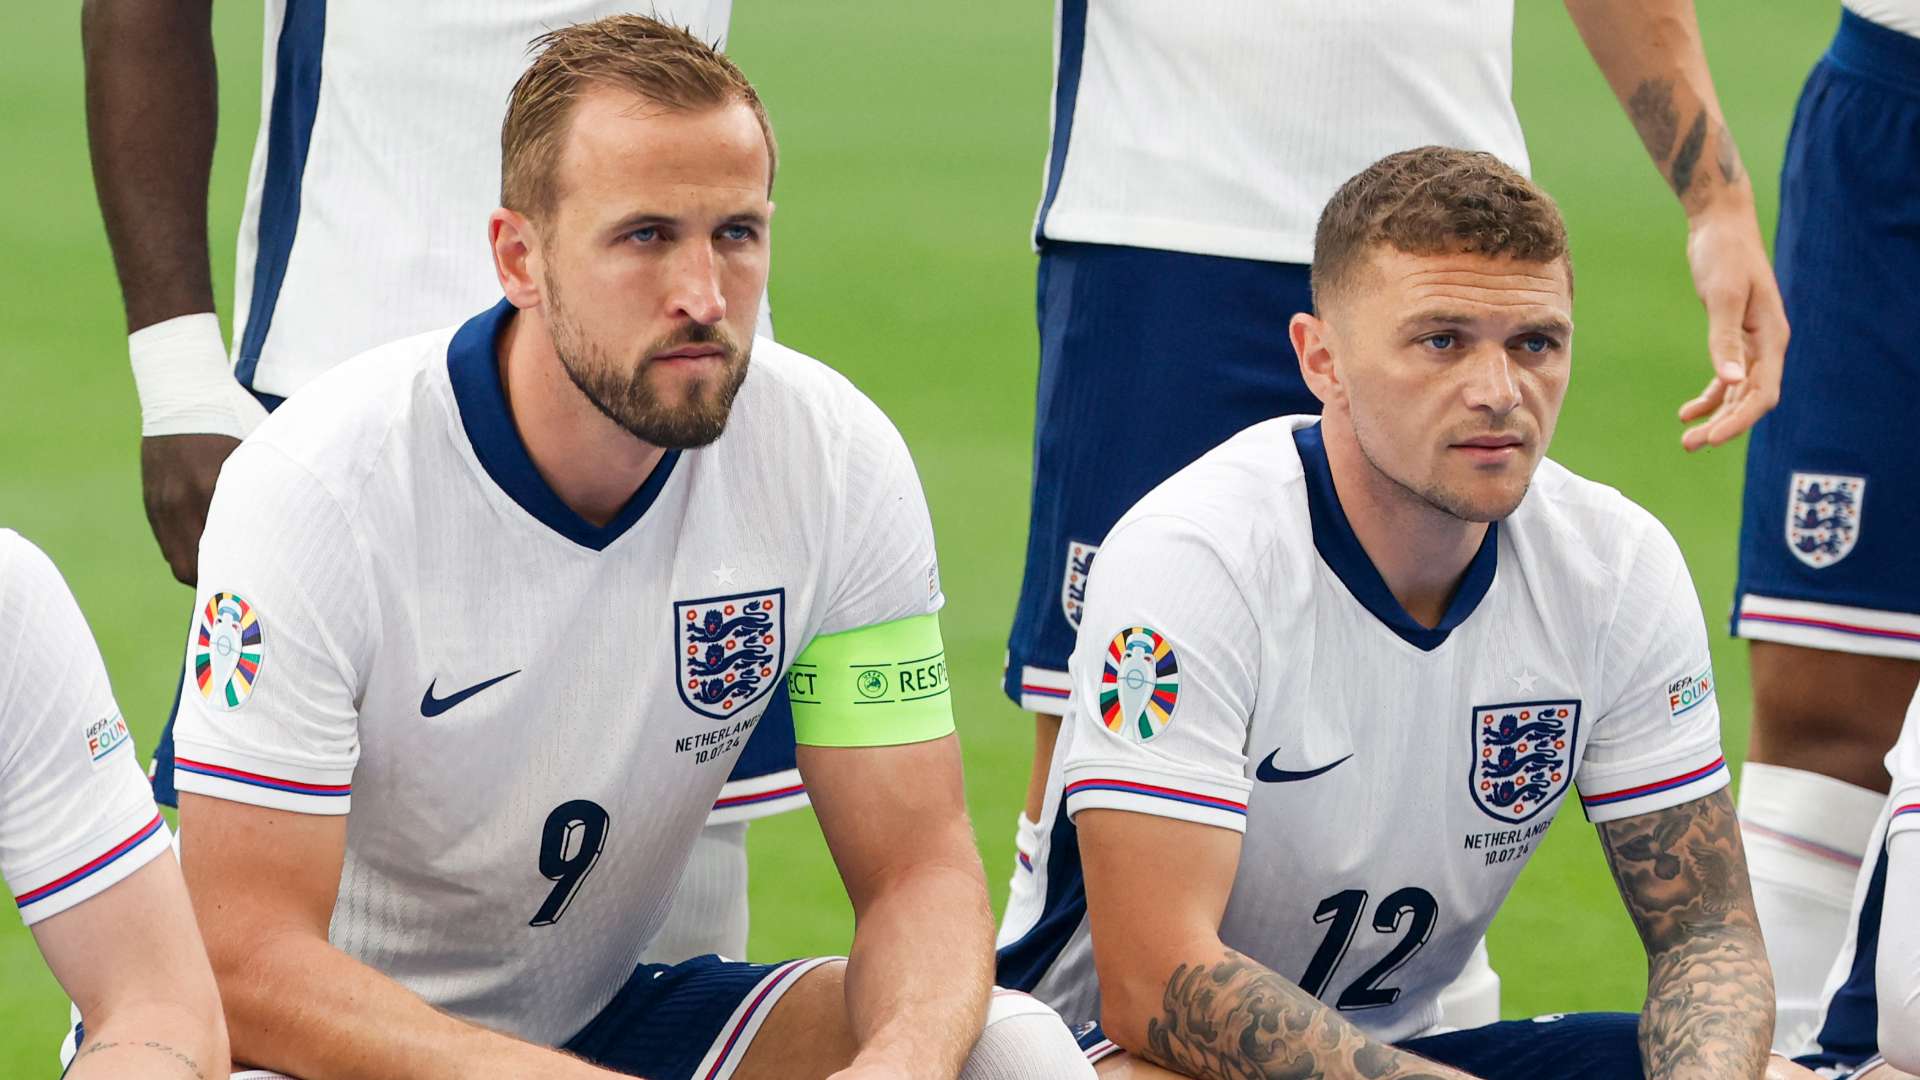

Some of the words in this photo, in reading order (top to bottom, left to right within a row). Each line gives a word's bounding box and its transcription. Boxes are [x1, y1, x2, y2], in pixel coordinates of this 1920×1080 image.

[1668, 676, 1692, 695] UEFA
[86, 718, 108, 738] UEFA
[675, 714, 761, 754] NETHERLAND
[695, 737, 740, 765] 10.07.24
[528, 799, 610, 927] 9
[1485, 843, 1529, 867] 10.07.24
[1298, 886, 1439, 1011] 12
